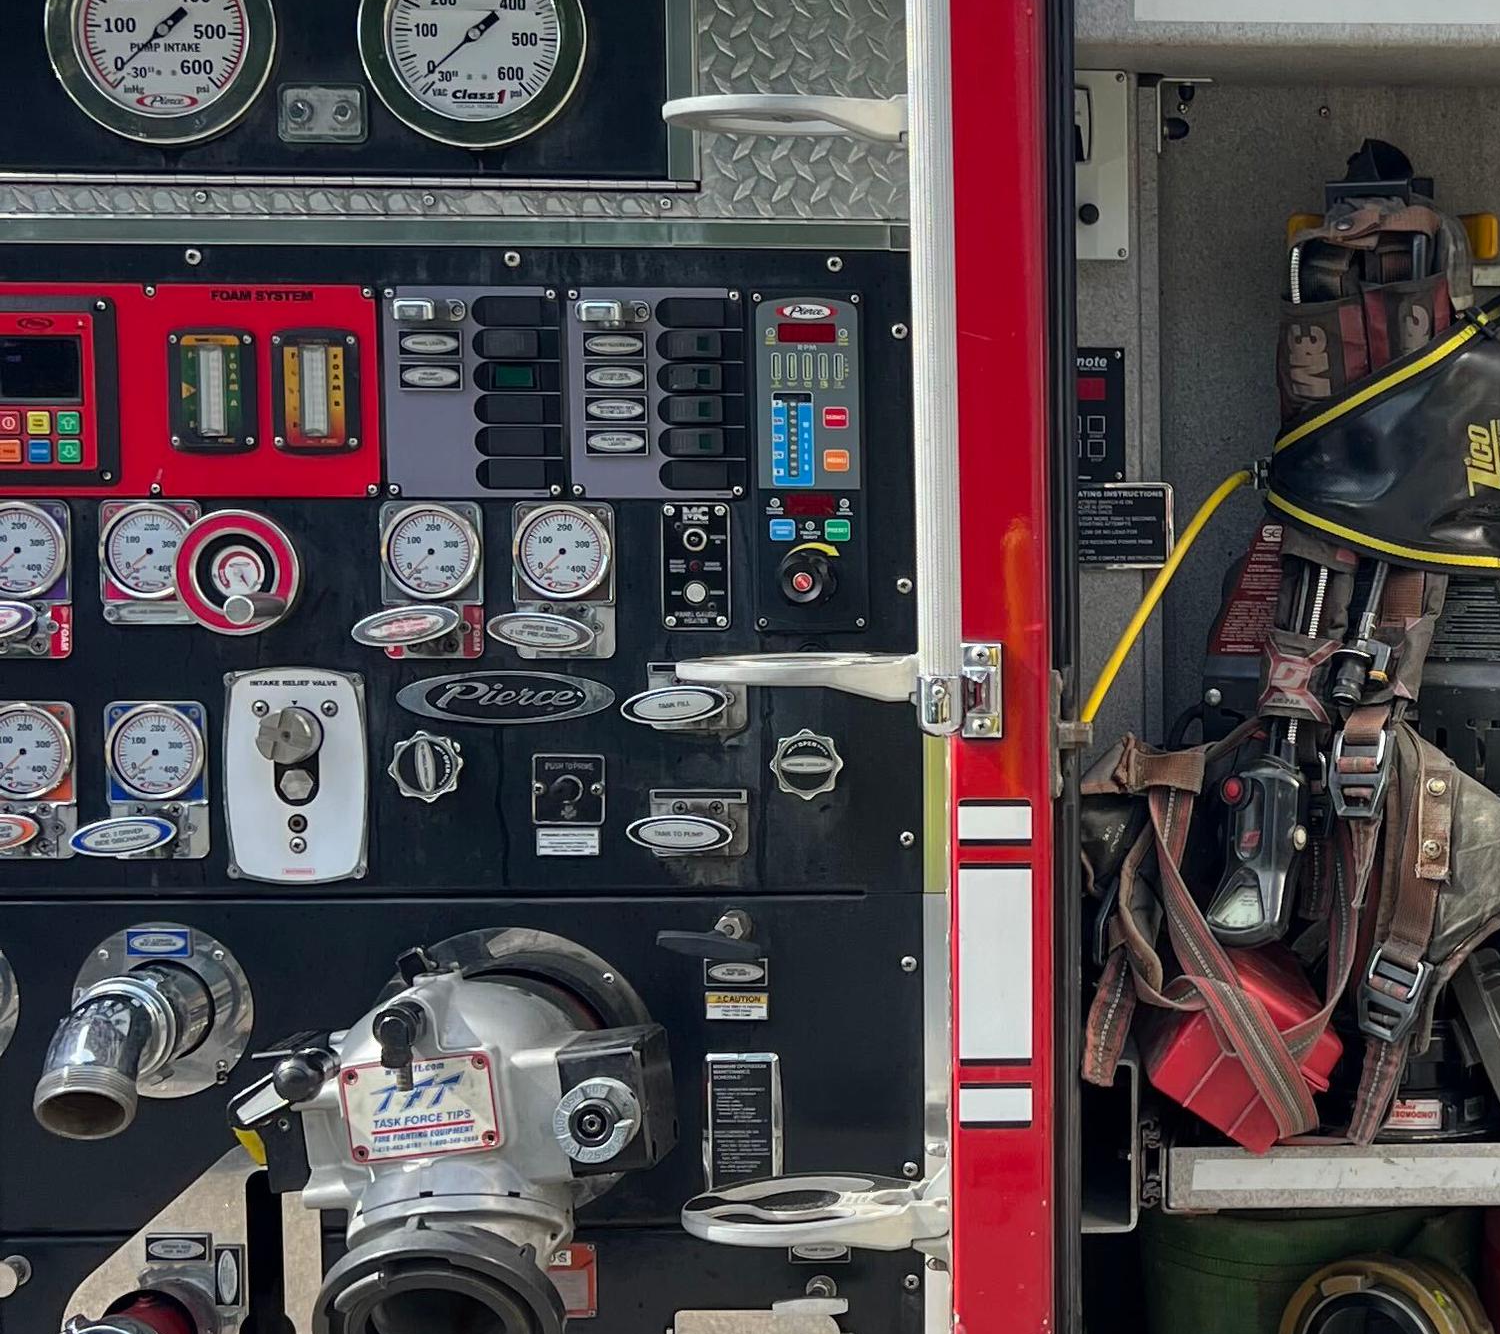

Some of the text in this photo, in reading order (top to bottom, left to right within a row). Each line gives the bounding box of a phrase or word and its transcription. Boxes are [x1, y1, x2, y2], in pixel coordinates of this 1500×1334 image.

[104, 18, 136, 33] 100
[414, 23, 438, 37] 100
[193, 24, 226, 39] 500
[512, 32, 538, 46] 500
[130, 43, 201, 52] PUMP INTAKE
[114, 56, 125, 71] 0
[180, 60, 214, 75] 600
[427, 61, 436, 74] 0
[497, 67, 524, 80] 600
[196, 85, 210, 94] psi
[432, 88, 448, 97] VAC
[510, 89, 523, 99] psi
[211, 290, 314, 302] FOAM SYSTEM
[790, 306, 824, 315] Pierce
[425, 524, 441, 532] 200
[29, 539, 45, 547] 300
[125, 536, 140, 544] 100
[26, 564, 42, 572] 400
[571, 565, 586, 573] 400
[522, 623, 545, 631] DRIVER
[60, 623, 69, 652] FOAM
[473, 624, 481, 652] FOAM
[435, 681, 578, 712] Pierce
[17, 723, 33, 731] 200
[150, 724, 166, 732] 200
[35, 740, 51, 748] 300
[168, 741, 183, 749] 300
[799, 741, 817, 749] OPEN
[32, 765, 47, 773] 400
[164, 765, 179, 773] 400
[545, 762, 564, 770] PUSH
[722, 995, 761, 1003] CAUTION
[373, 1109, 471, 1129] TASK FORCE TIPS
[373, 1125, 474, 1143] FIRE FIGHTING EQUIPMENT
